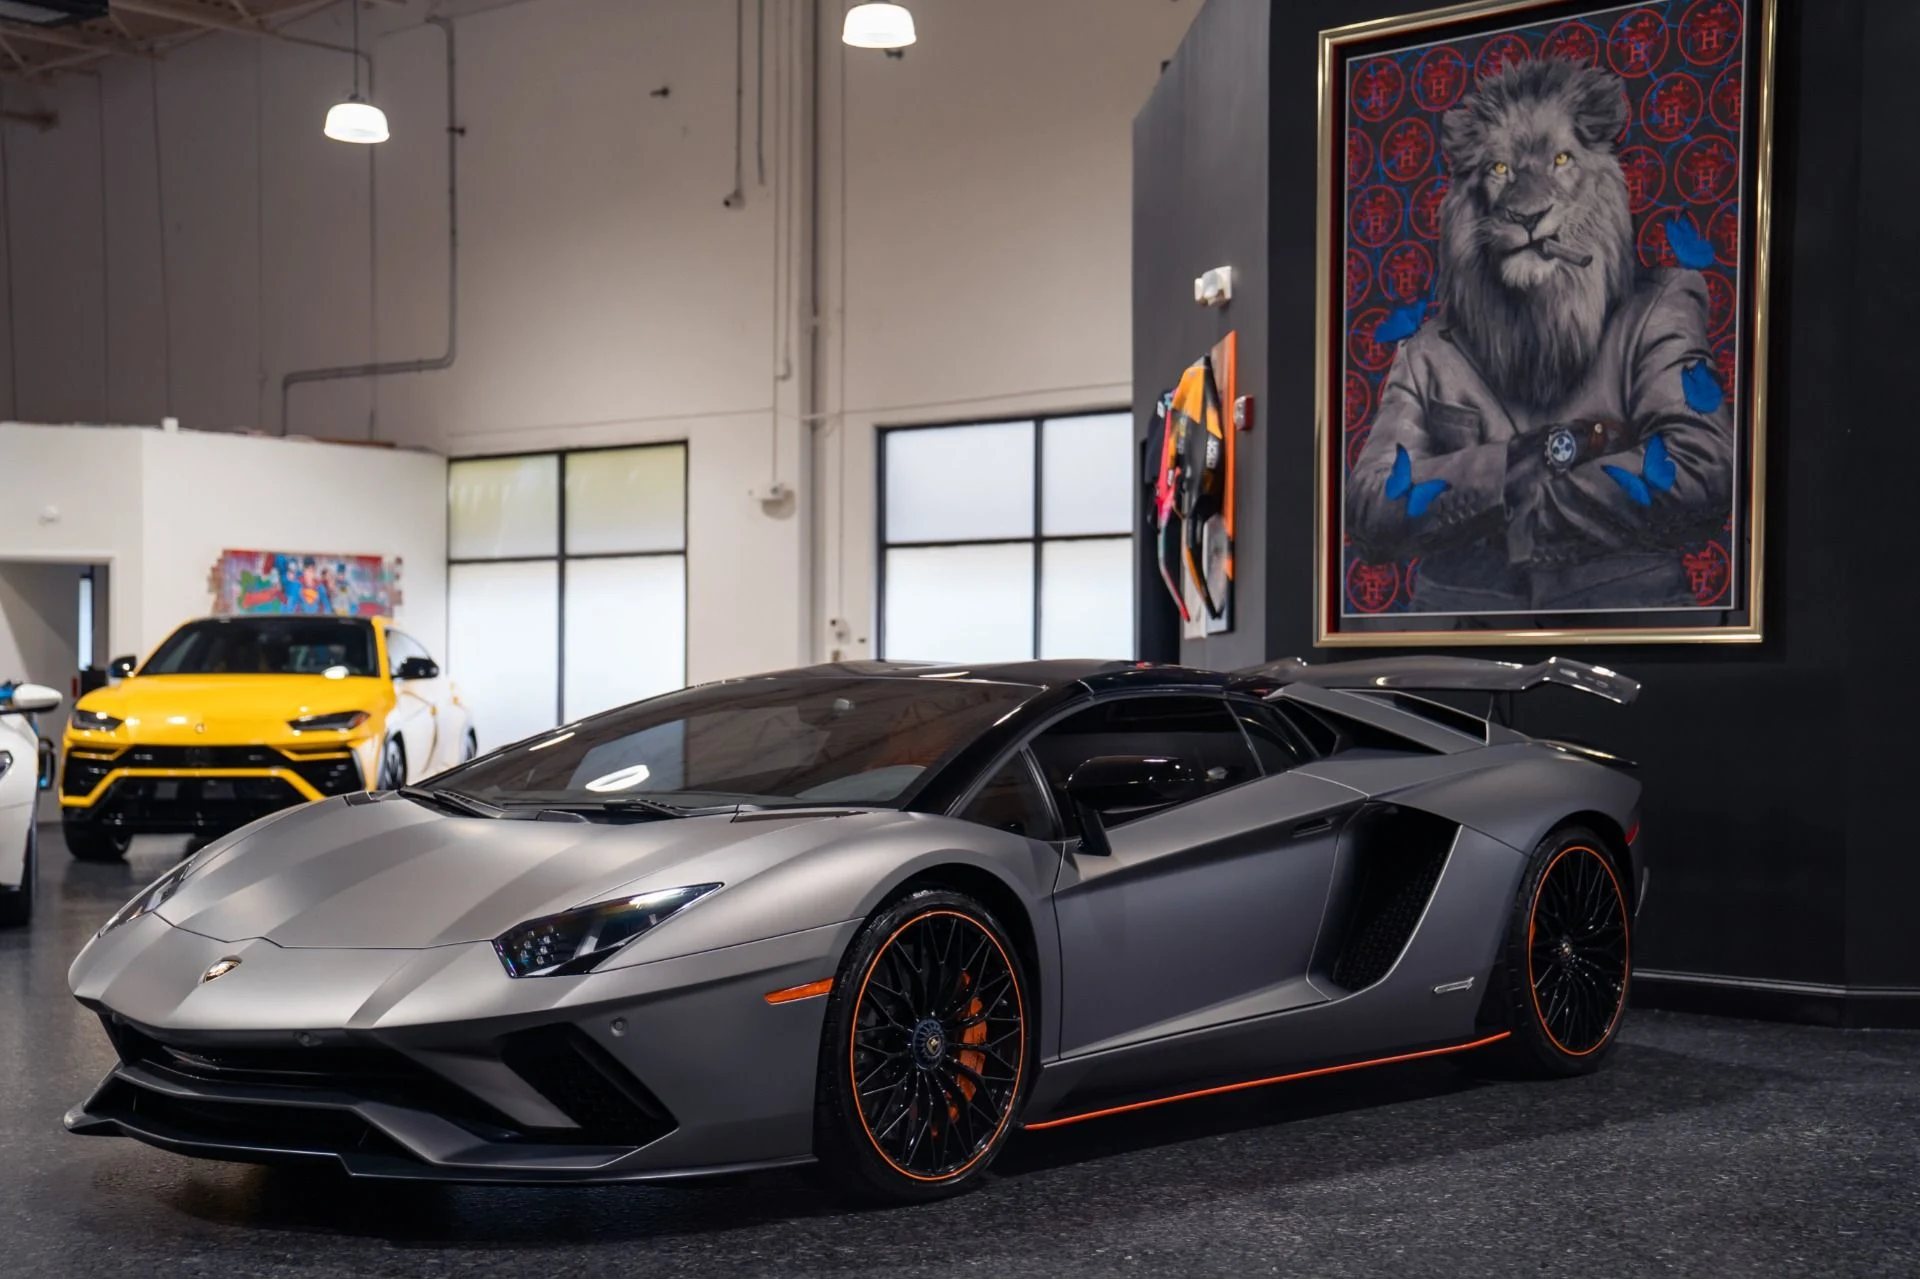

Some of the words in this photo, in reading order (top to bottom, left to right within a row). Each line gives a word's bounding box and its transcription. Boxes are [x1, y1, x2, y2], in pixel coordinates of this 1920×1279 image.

[1700, 28, 1721, 49] H
[1629, 42, 1647, 62] H
[1431, 78, 1447, 98] H
[1663, 105, 1683, 128] H
[1696, 168, 1717, 190] H
[1363, 580, 1383, 601] H
[1691, 571, 1712, 593] H
